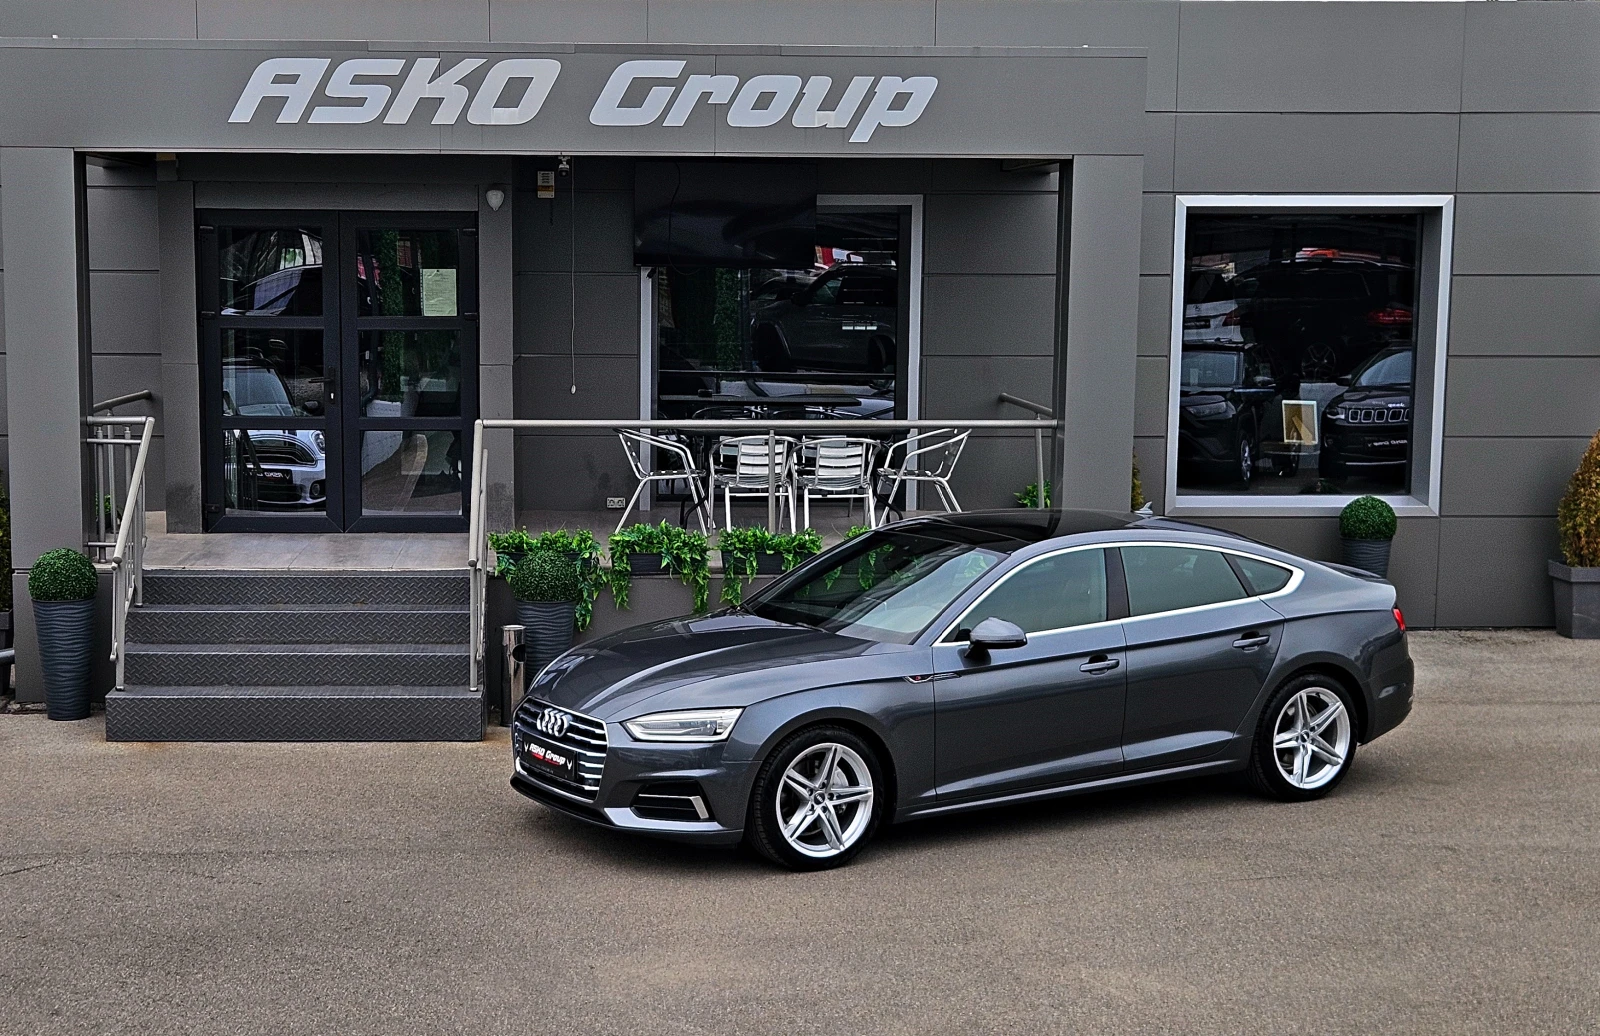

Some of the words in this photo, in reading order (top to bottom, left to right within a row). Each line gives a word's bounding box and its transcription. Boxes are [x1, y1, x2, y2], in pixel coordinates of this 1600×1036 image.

[227, 57, 562, 125] ASKO
[589, 60, 939, 142] Group
[529, 743, 546, 757] ASKO
[545, 750, 567, 766] Group
